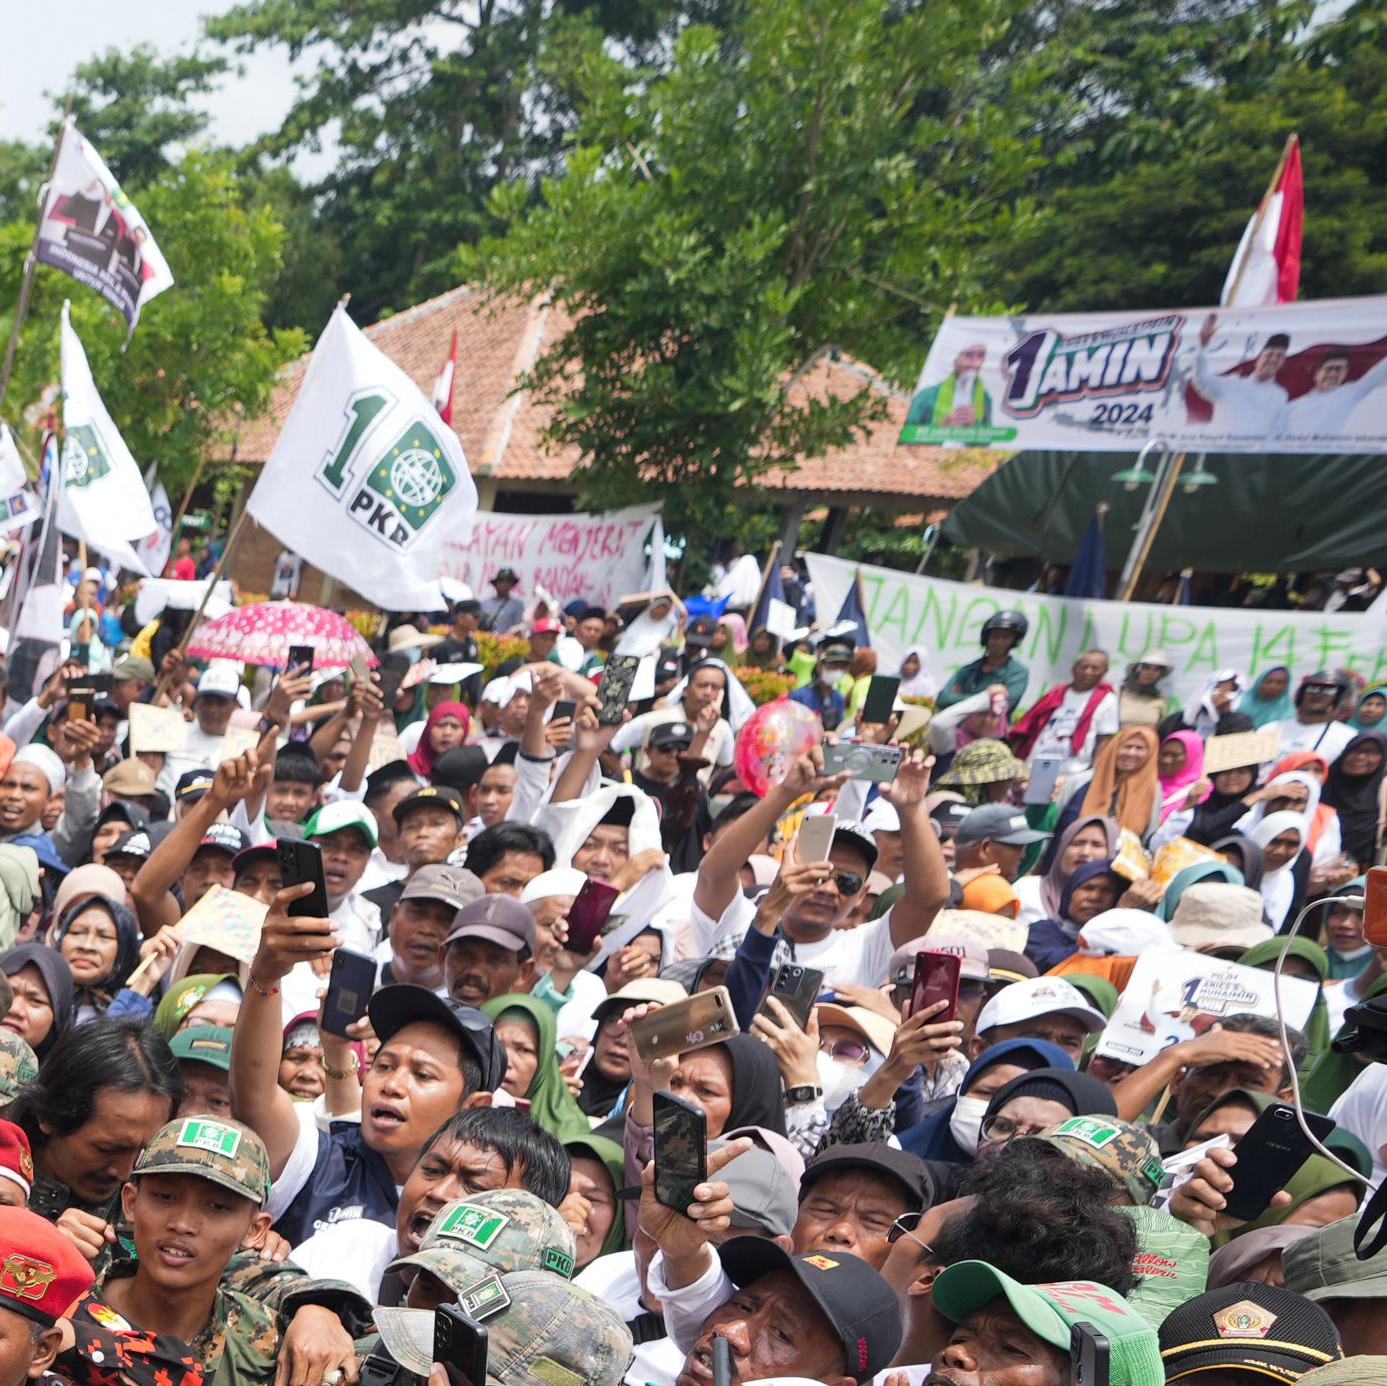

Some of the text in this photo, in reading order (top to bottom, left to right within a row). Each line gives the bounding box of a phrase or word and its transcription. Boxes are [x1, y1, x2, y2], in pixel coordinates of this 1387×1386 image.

[1038, 331, 1170, 396] AMIN
[1093, 402, 1155, 426] 2024
[322, 393, 389, 493] 1
[1250, 624, 1296, 672] 14
[1147, 1164, 1164, 1185] PK
[450, 1225, 474, 1239] PKB
[546, 1251, 571, 1274] PKB
